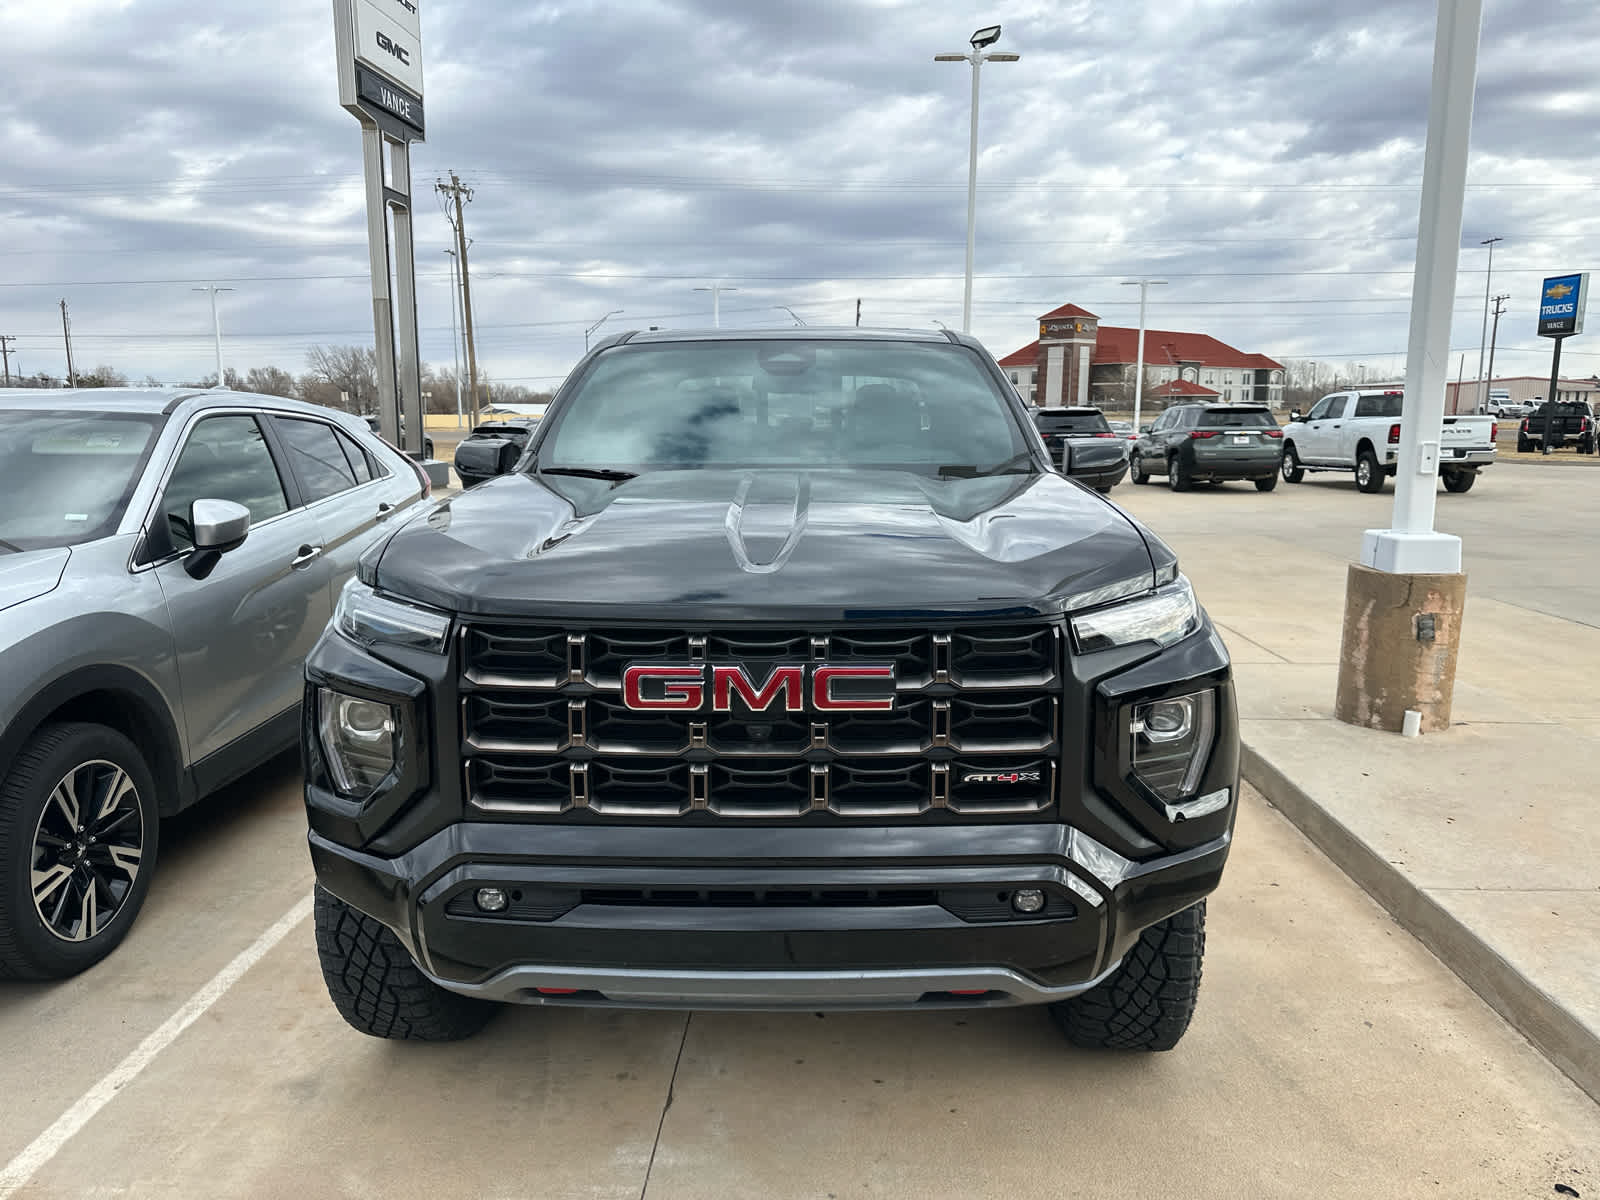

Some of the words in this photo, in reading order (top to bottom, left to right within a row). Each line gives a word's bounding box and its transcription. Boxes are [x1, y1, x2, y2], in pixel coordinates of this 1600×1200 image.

[376, 31, 410, 66] GMC
[380, 87, 411, 119] VANCE
[1542, 303, 1574, 315] TRUCKS
[1547, 321, 1564, 329] VANCE
[623, 664, 895, 712] GMC
[964, 772, 1040, 783] AT4X
